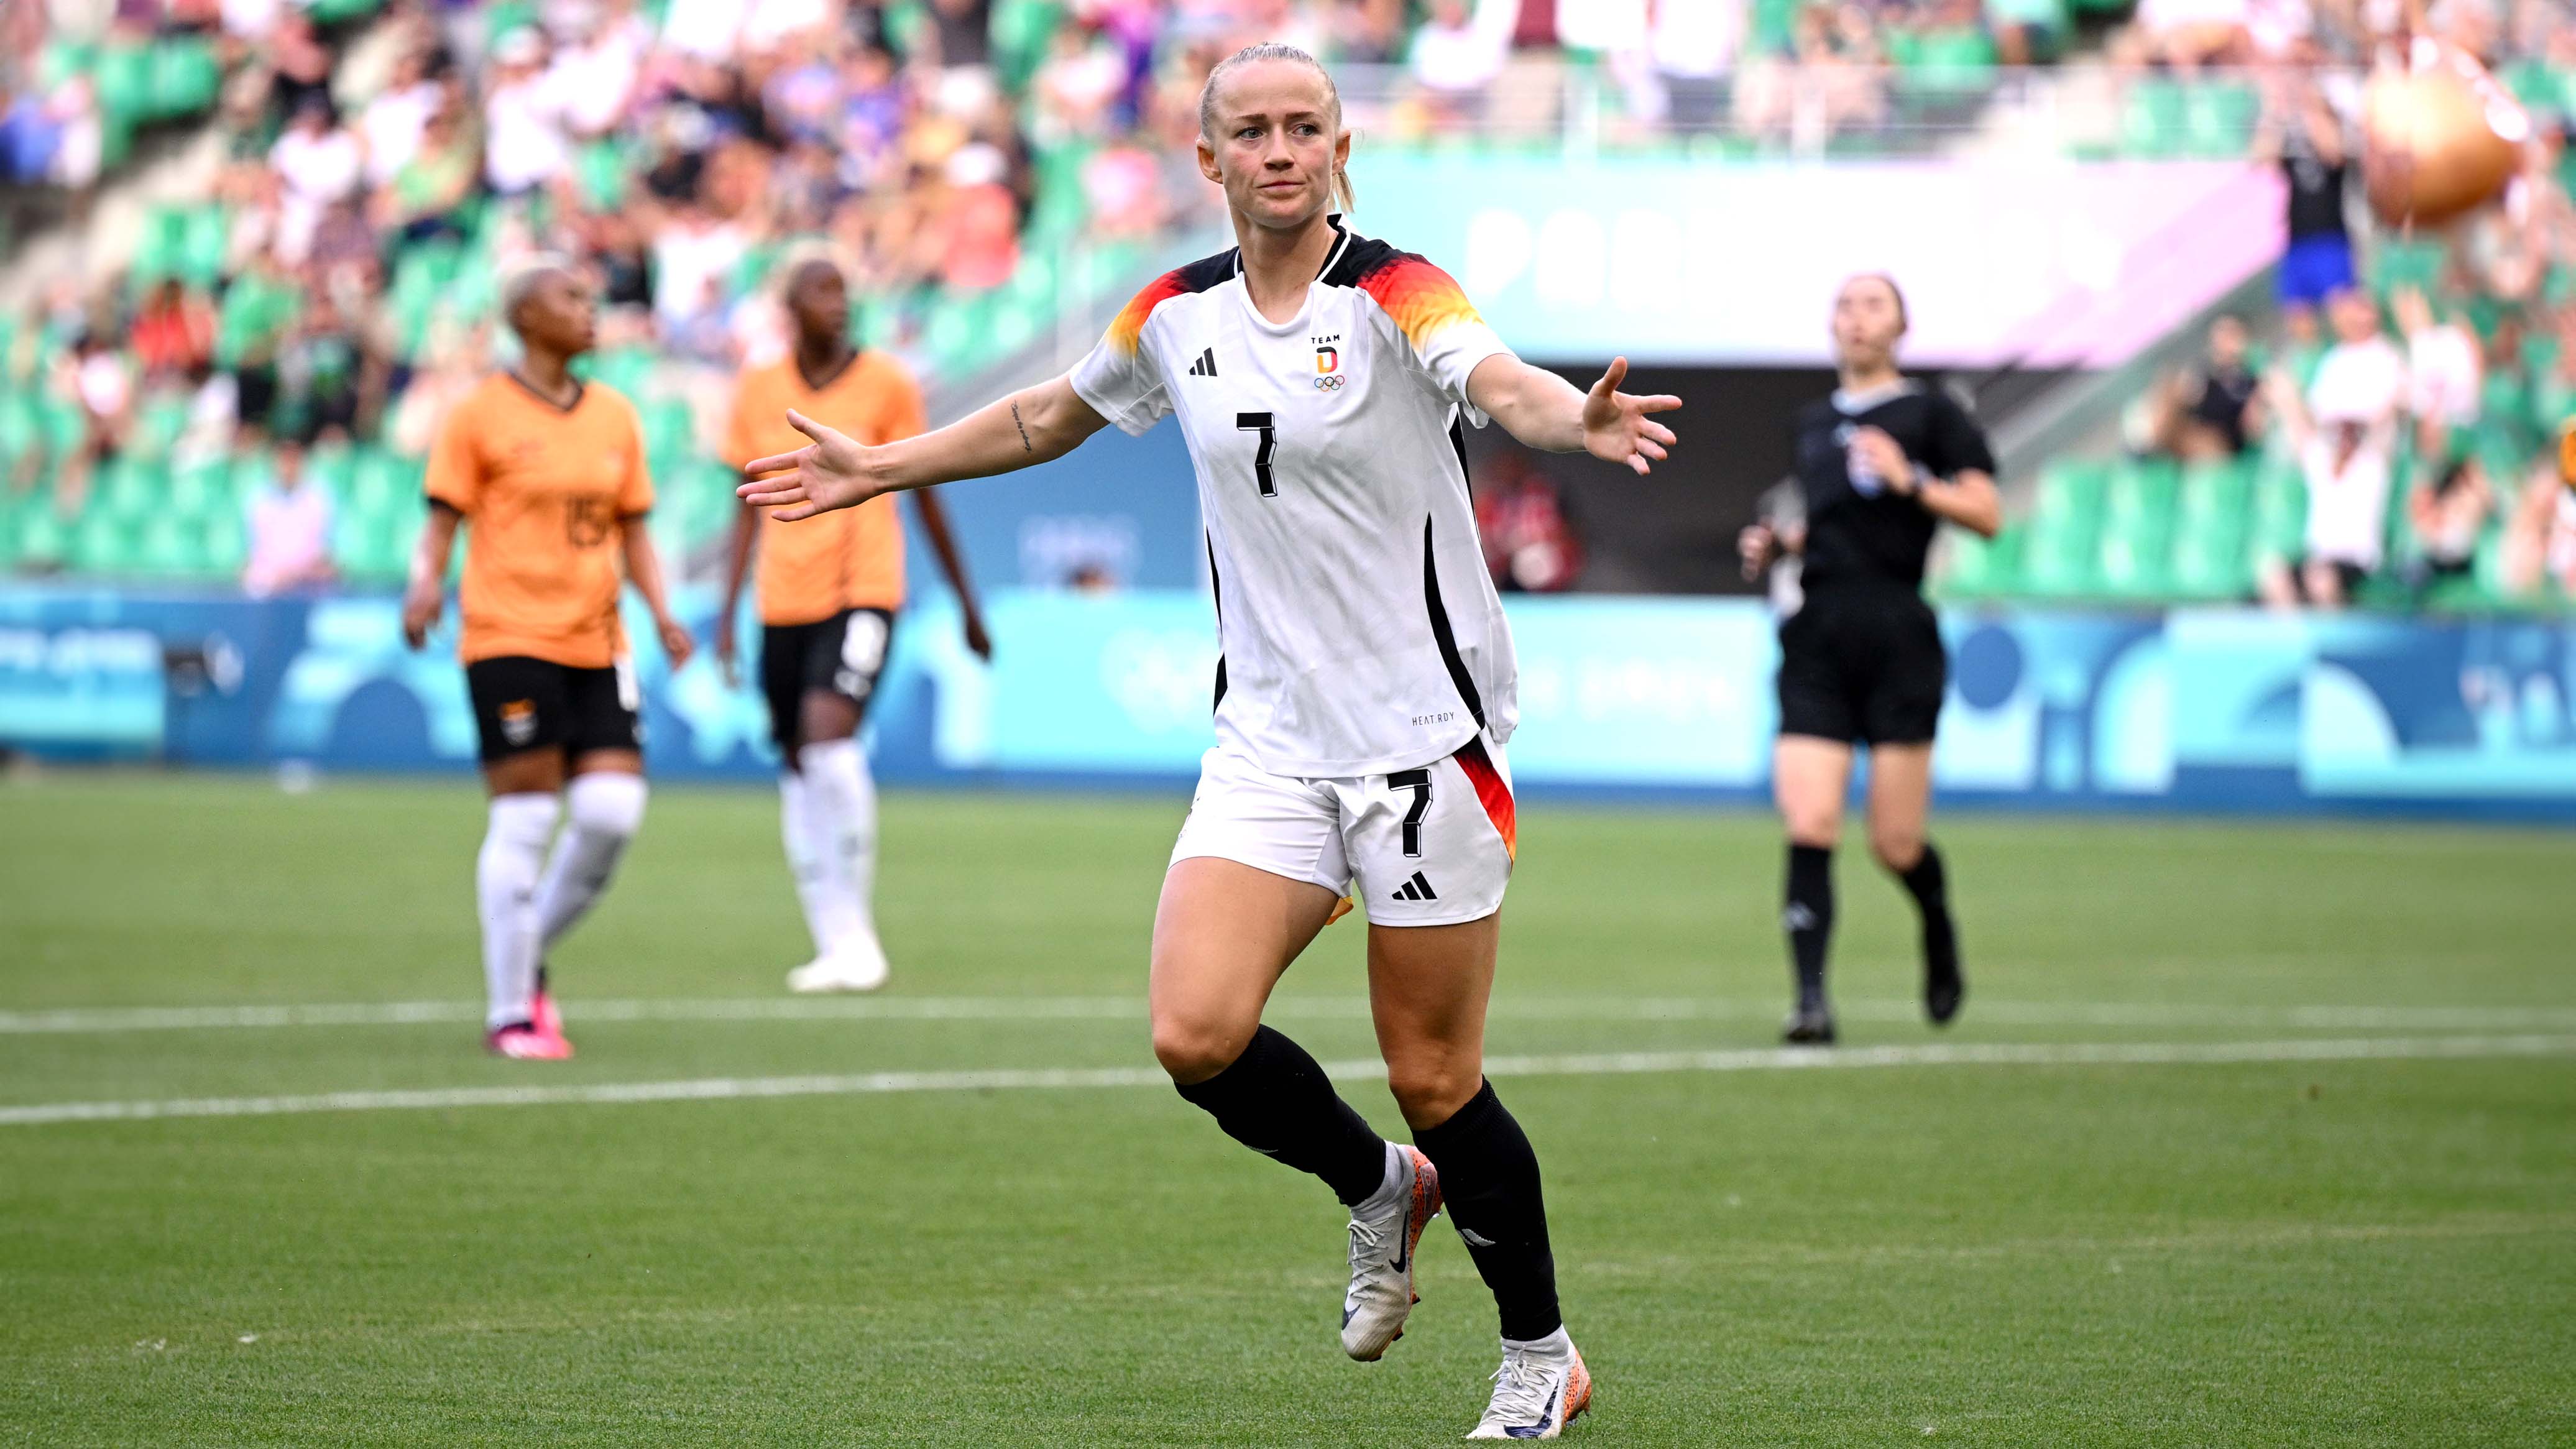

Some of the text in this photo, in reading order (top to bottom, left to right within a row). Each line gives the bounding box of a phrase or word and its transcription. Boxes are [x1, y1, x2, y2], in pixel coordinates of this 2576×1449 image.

[1310, 334, 1340, 344] TEAM
[1316, 346, 1338, 374] D
[1236, 412, 1278, 497] 7
[1412, 711, 1455, 727] HEAT.RDY
[1386, 768, 1433, 858] 7
